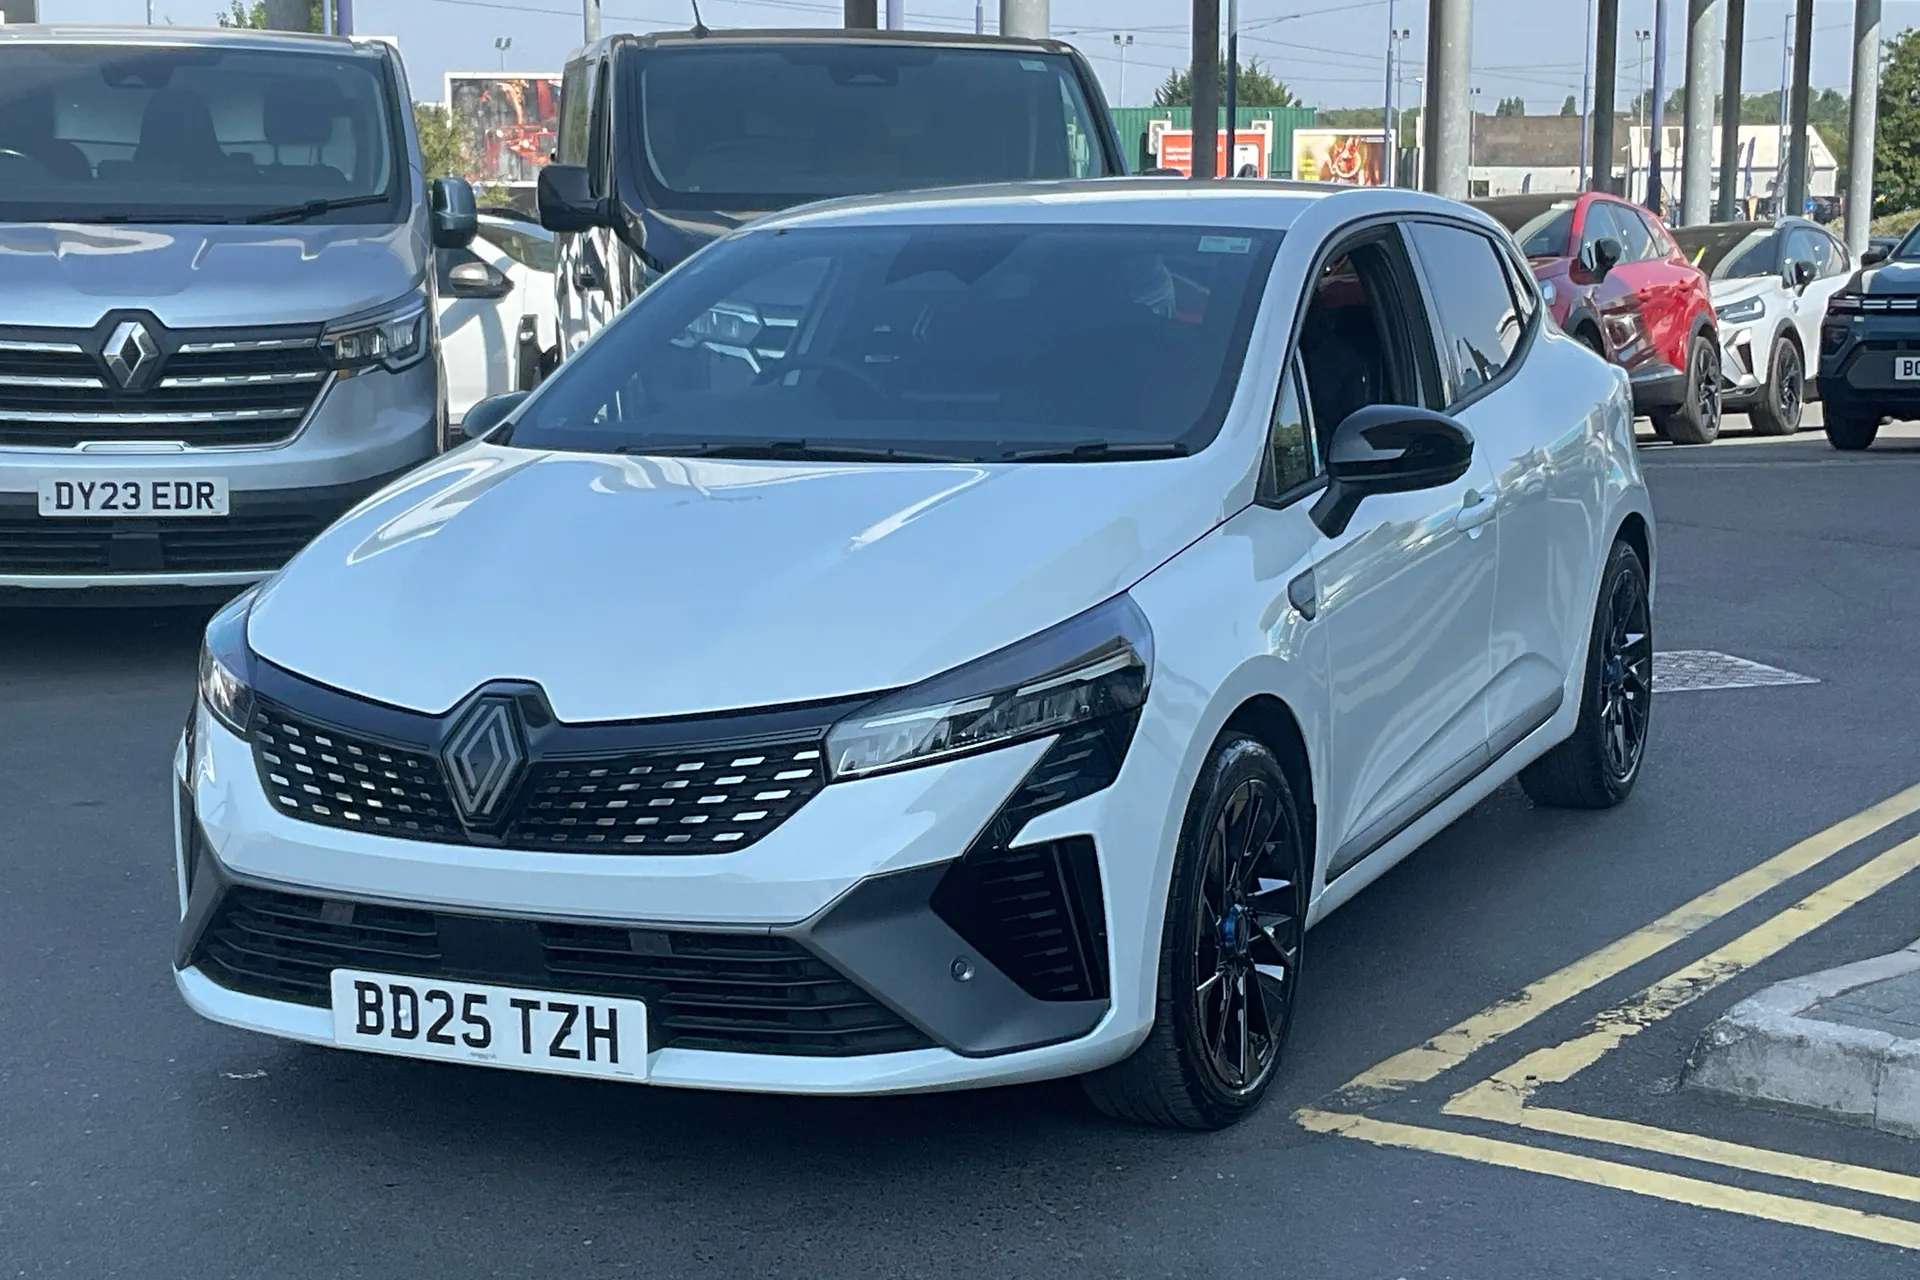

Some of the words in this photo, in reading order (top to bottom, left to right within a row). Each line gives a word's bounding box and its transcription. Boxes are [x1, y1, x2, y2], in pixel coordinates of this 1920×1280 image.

[55, 481, 141, 510] DY23
[152, 481, 215, 510] EDR
[354, 980, 491, 1048] BD25
[510, 998, 619, 1063] TZH
